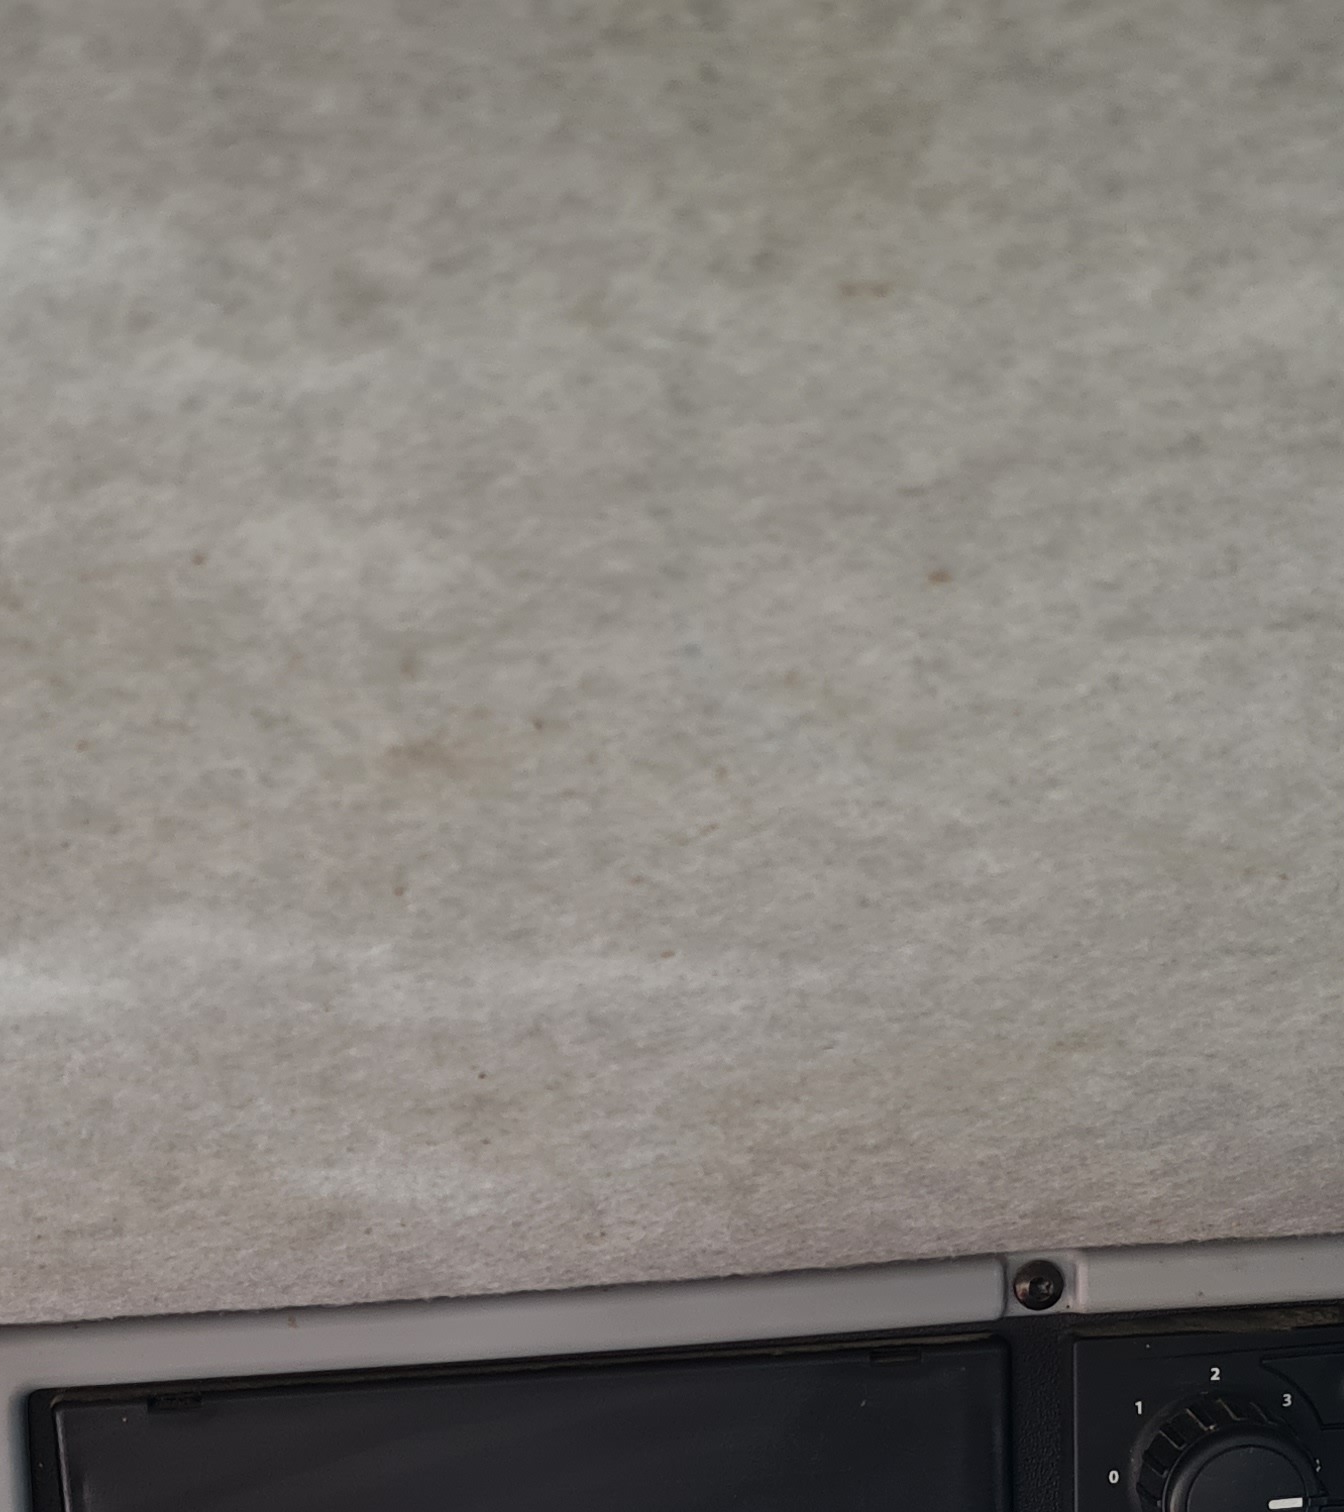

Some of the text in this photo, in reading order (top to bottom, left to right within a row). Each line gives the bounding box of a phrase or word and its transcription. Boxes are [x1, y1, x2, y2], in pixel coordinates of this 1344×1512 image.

[1209, 1366, 1222, 1382] 2
[1134, 1399, 1144, 1416] 1
[1281, 1392, 1293, 1408] 3
